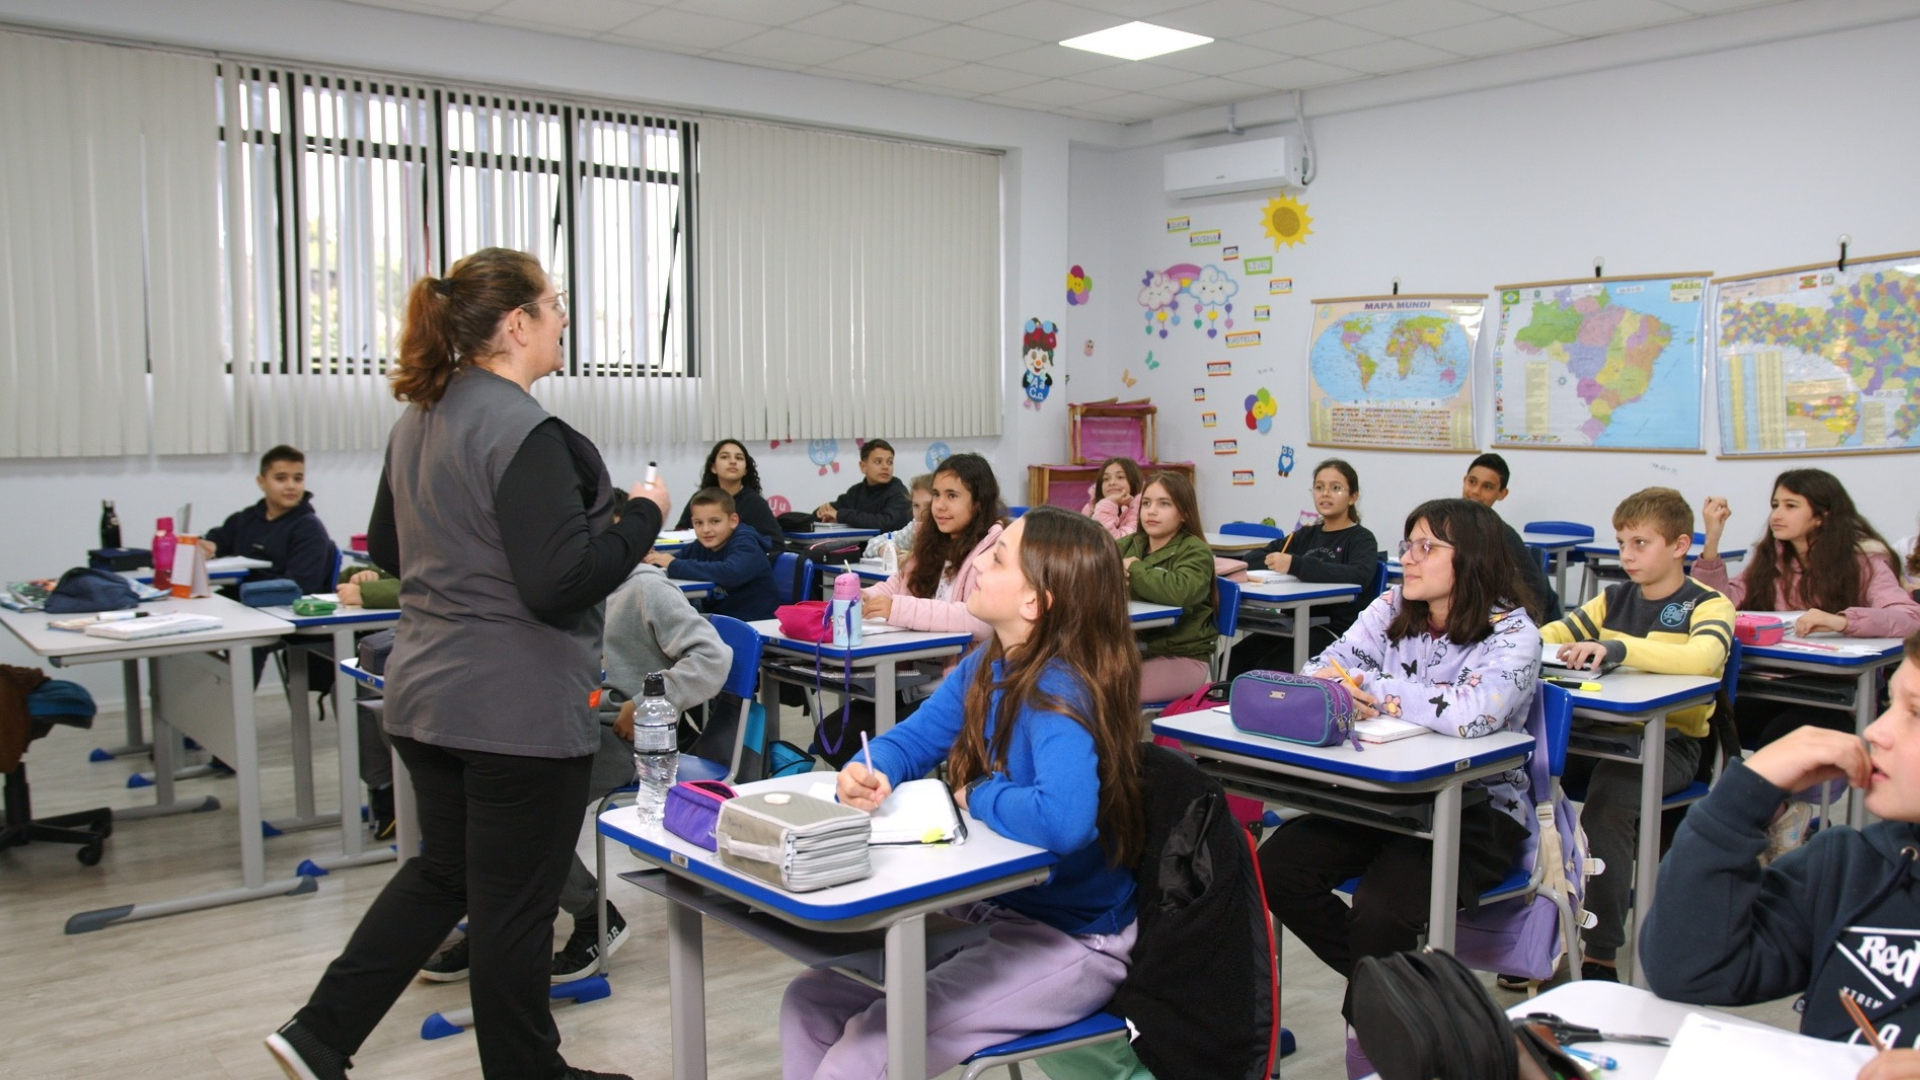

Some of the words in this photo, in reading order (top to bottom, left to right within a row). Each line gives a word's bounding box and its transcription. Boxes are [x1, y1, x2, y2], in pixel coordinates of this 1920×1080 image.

[1671, 282, 1702, 290] BRASIL
[1364, 302, 1393, 310] MAPA
[1396, 301, 1431, 309] MUNDI
[768, 498, 787, 512] Uu
[1856, 936, 1920, 988] Red
